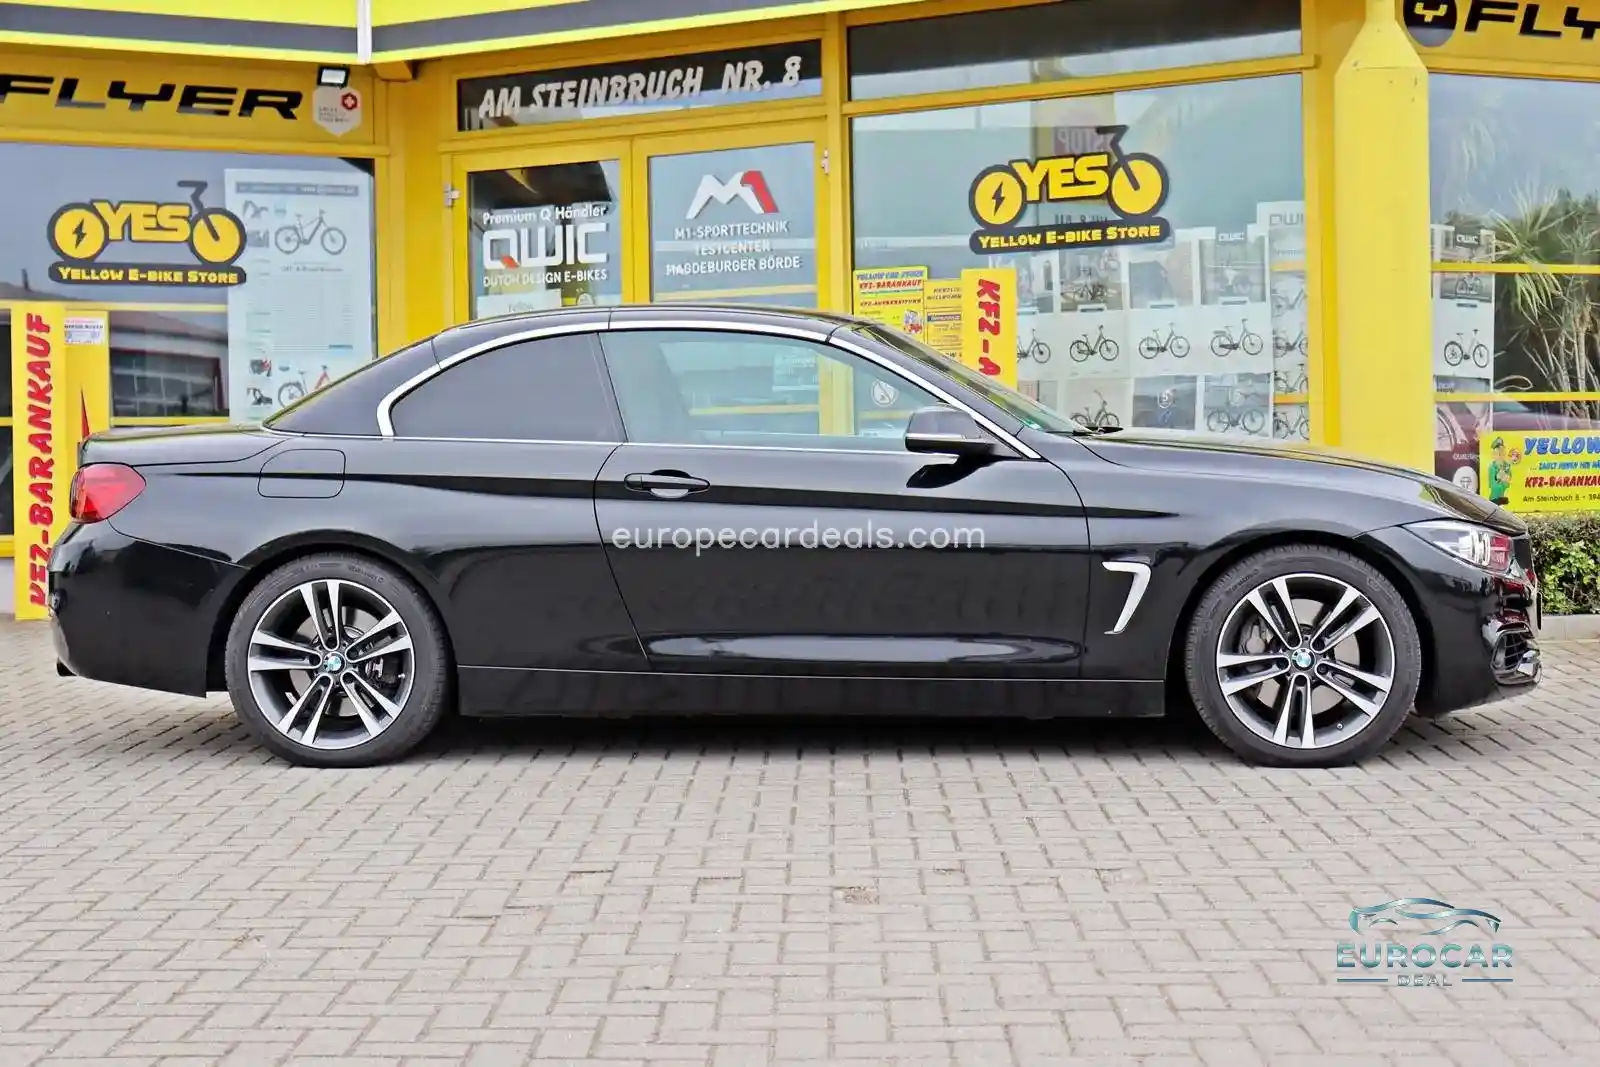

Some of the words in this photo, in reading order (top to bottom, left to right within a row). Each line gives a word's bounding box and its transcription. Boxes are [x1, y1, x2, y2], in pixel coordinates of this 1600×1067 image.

[0, 74, 303, 120] FLYER
[479, 86, 521, 119] AM
[530, 66, 704, 111] STEINBRUCH
[722, 60, 772, 95] NR.
[781, 55, 803, 87] 8
[1011, 154, 1109, 201] YES
[93, 201, 191, 242] YES
[482, 208, 537, 225] Premium
[540, 207, 551, 222] Q
[555, 203, 607, 219] Händler
[674, 220, 789, 240] M1-SPORTTECHNIK
[978, 230, 1042, 249] YELLOW
[1046, 228, 1102, 244] E-BIKE
[1106, 224, 1160, 240] STORE
[483, 222, 608, 269] QWIC
[695, 239, 772, 256] TESTCENTER
[58, 266, 125, 281] YELLOW
[128, 268, 184, 283] E-BIKE
[188, 269, 239, 285] STORE
[665, 256, 757, 276] MAGDEBURGER
[759, 253, 801, 271] BÖRDE
[483, 273, 520, 288] DUTCH
[522, 271, 562, 286] DESIGN
[564, 268, 608, 283] E-BIKES
[1537, 493, 1573, 502] Steinbruch
